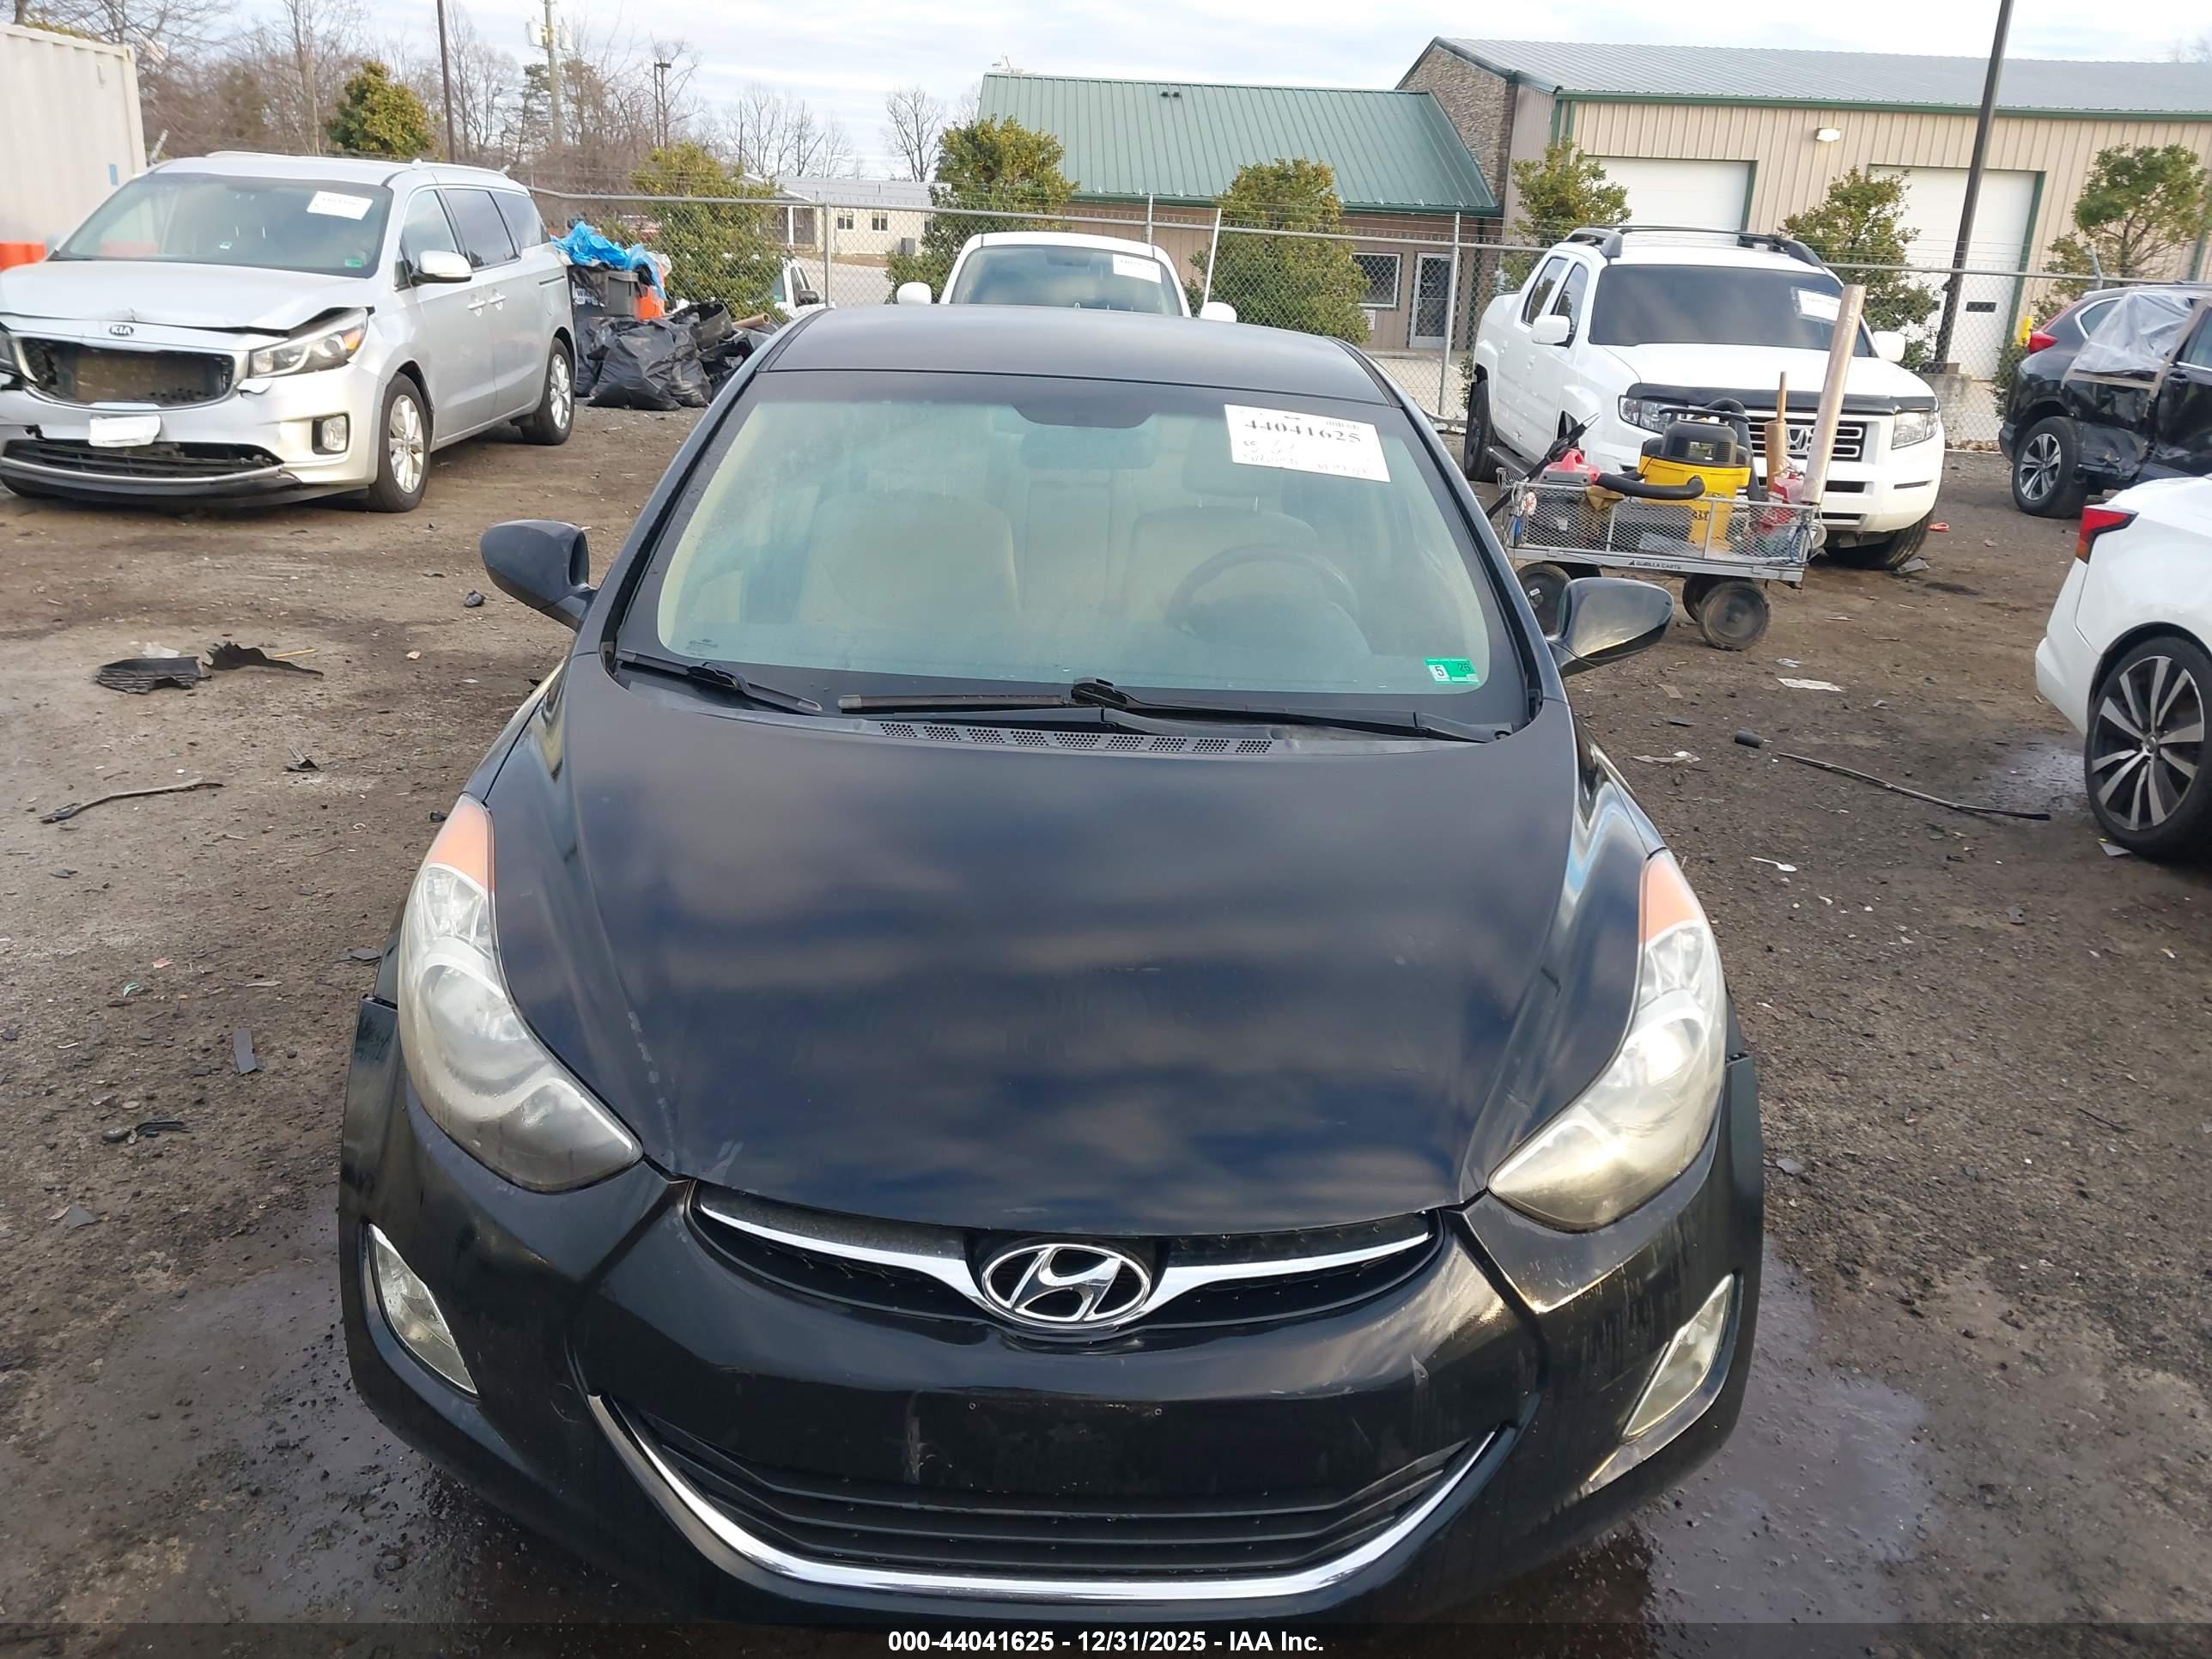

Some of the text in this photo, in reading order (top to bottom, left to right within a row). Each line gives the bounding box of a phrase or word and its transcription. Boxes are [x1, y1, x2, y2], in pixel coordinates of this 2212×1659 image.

[112, 325, 131, 334] KIA
[1244, 419, 1362, 443] 44041625
[1435, 665, 1445, 677] 5
